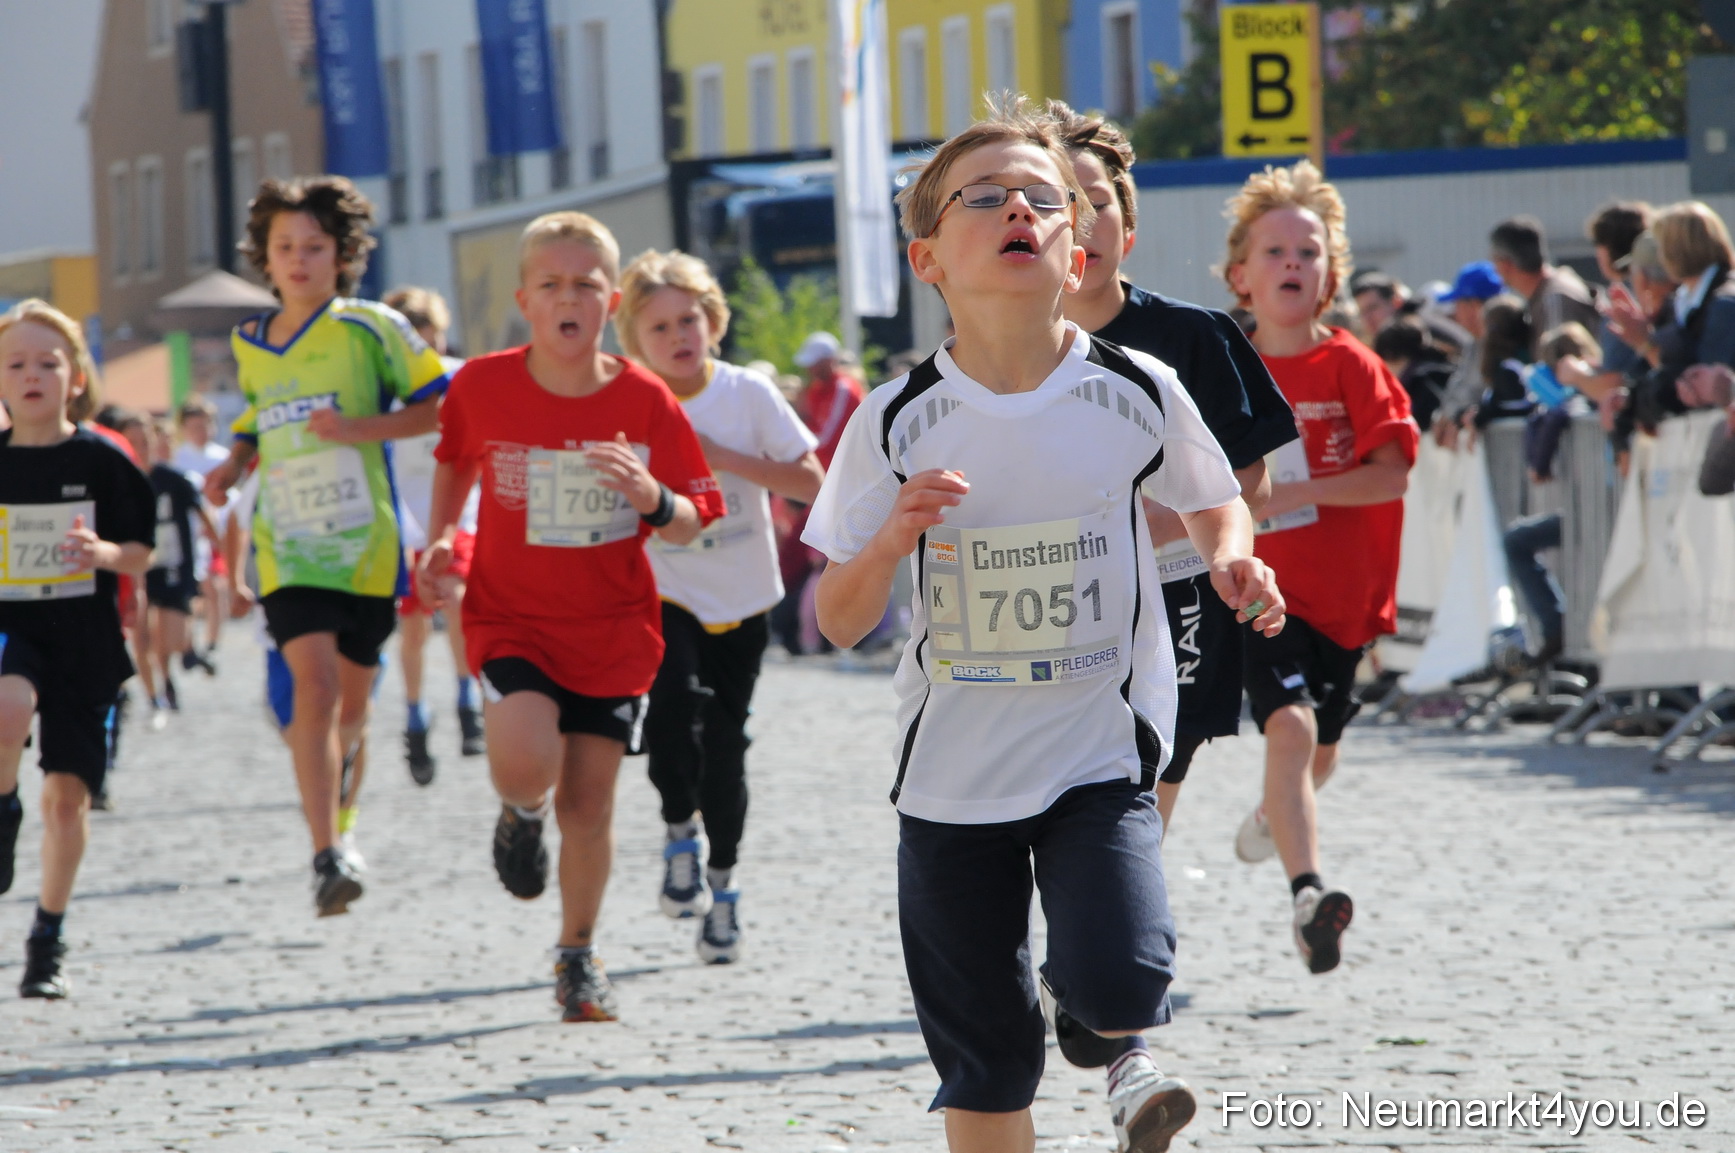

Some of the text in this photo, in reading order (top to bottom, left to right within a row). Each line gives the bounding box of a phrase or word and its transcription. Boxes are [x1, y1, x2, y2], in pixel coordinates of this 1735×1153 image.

[1232, 12, 1305, 39] Block
[1250, 53, 1295, 119] B
[296, 477, 361, 510] 7232
[972, 532, 1108, 570] Constantin
[933, 586, 944, 608] K
[980, 578, 1102, 632] 7051
[951, 666, 1001, 677] BOCK
[1054, 647, 1118, 672] PFLEIDERER
[1055, 660, 1120, 680] AKTIENGESELLSCHAFT
